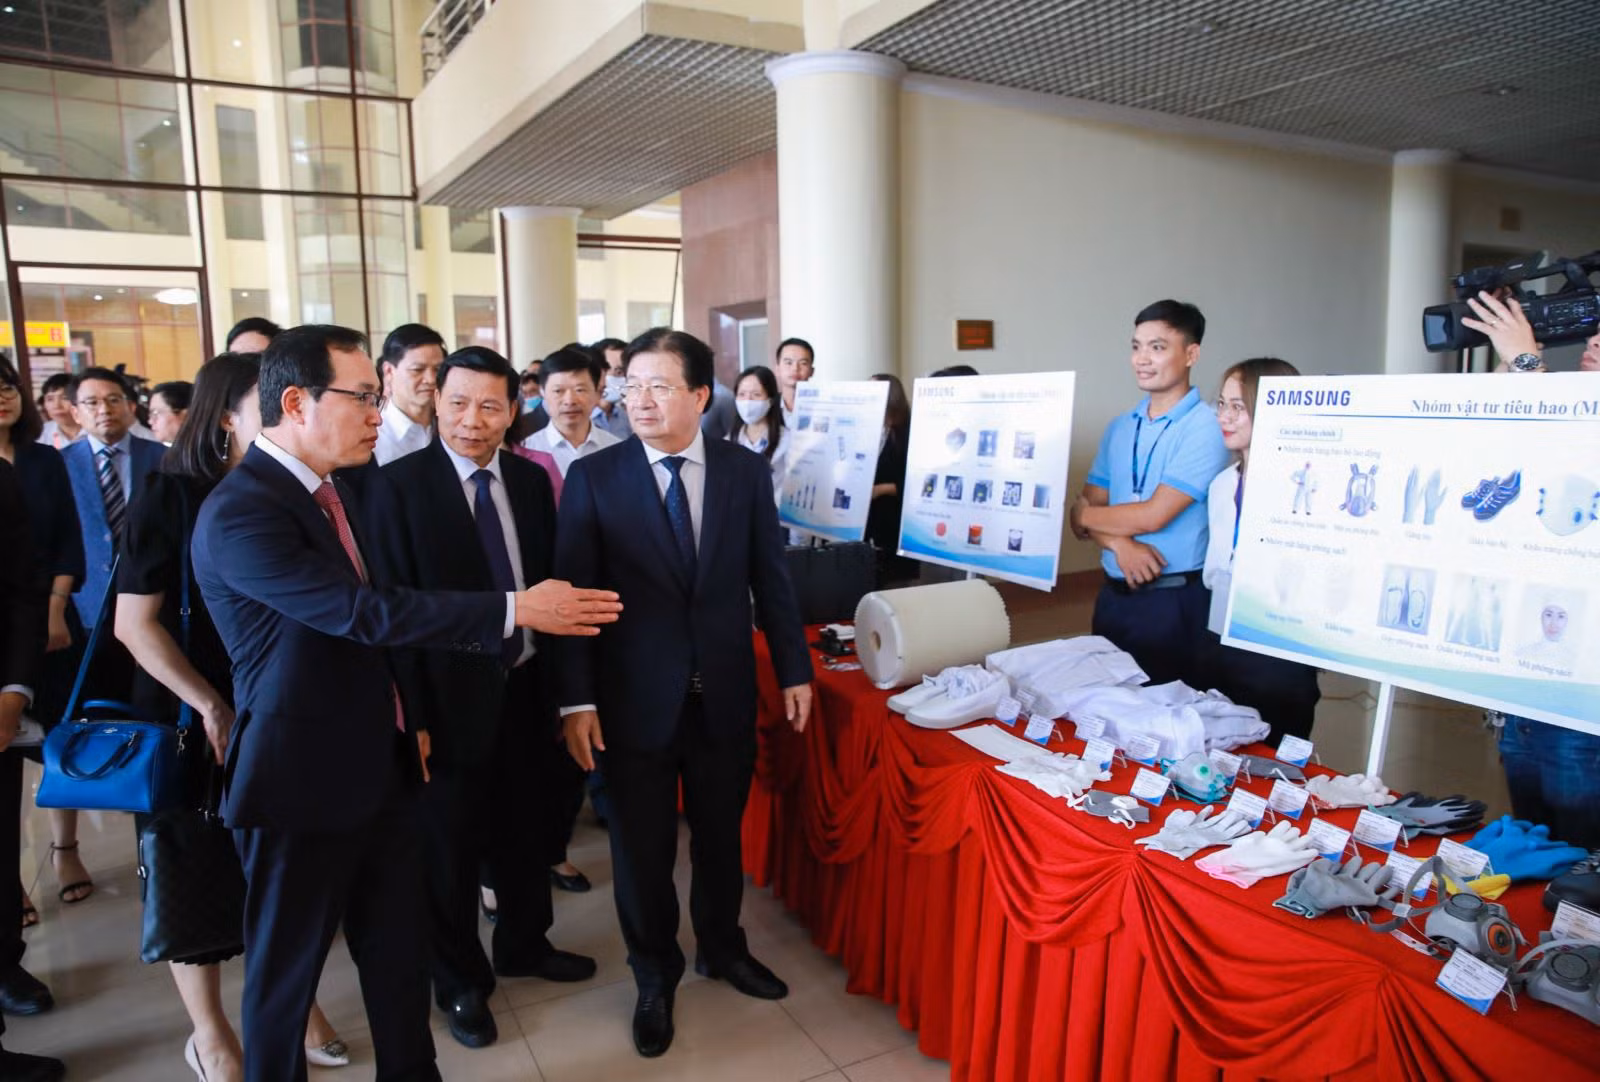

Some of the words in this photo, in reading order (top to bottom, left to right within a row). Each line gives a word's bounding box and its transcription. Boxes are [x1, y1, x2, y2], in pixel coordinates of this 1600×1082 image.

[1266, 389, 1351, 406] SAMSUNG
[1412, 399, 1452, 414] Nhóm
[1456, 400, 1479, 416] vật
[1483, 400, 1500, 414] tư
[1504, 399, 1533, 415] tiêu
[1538, 400, 1568, 415] hao
[1573, 399, 1600, 416] (M
